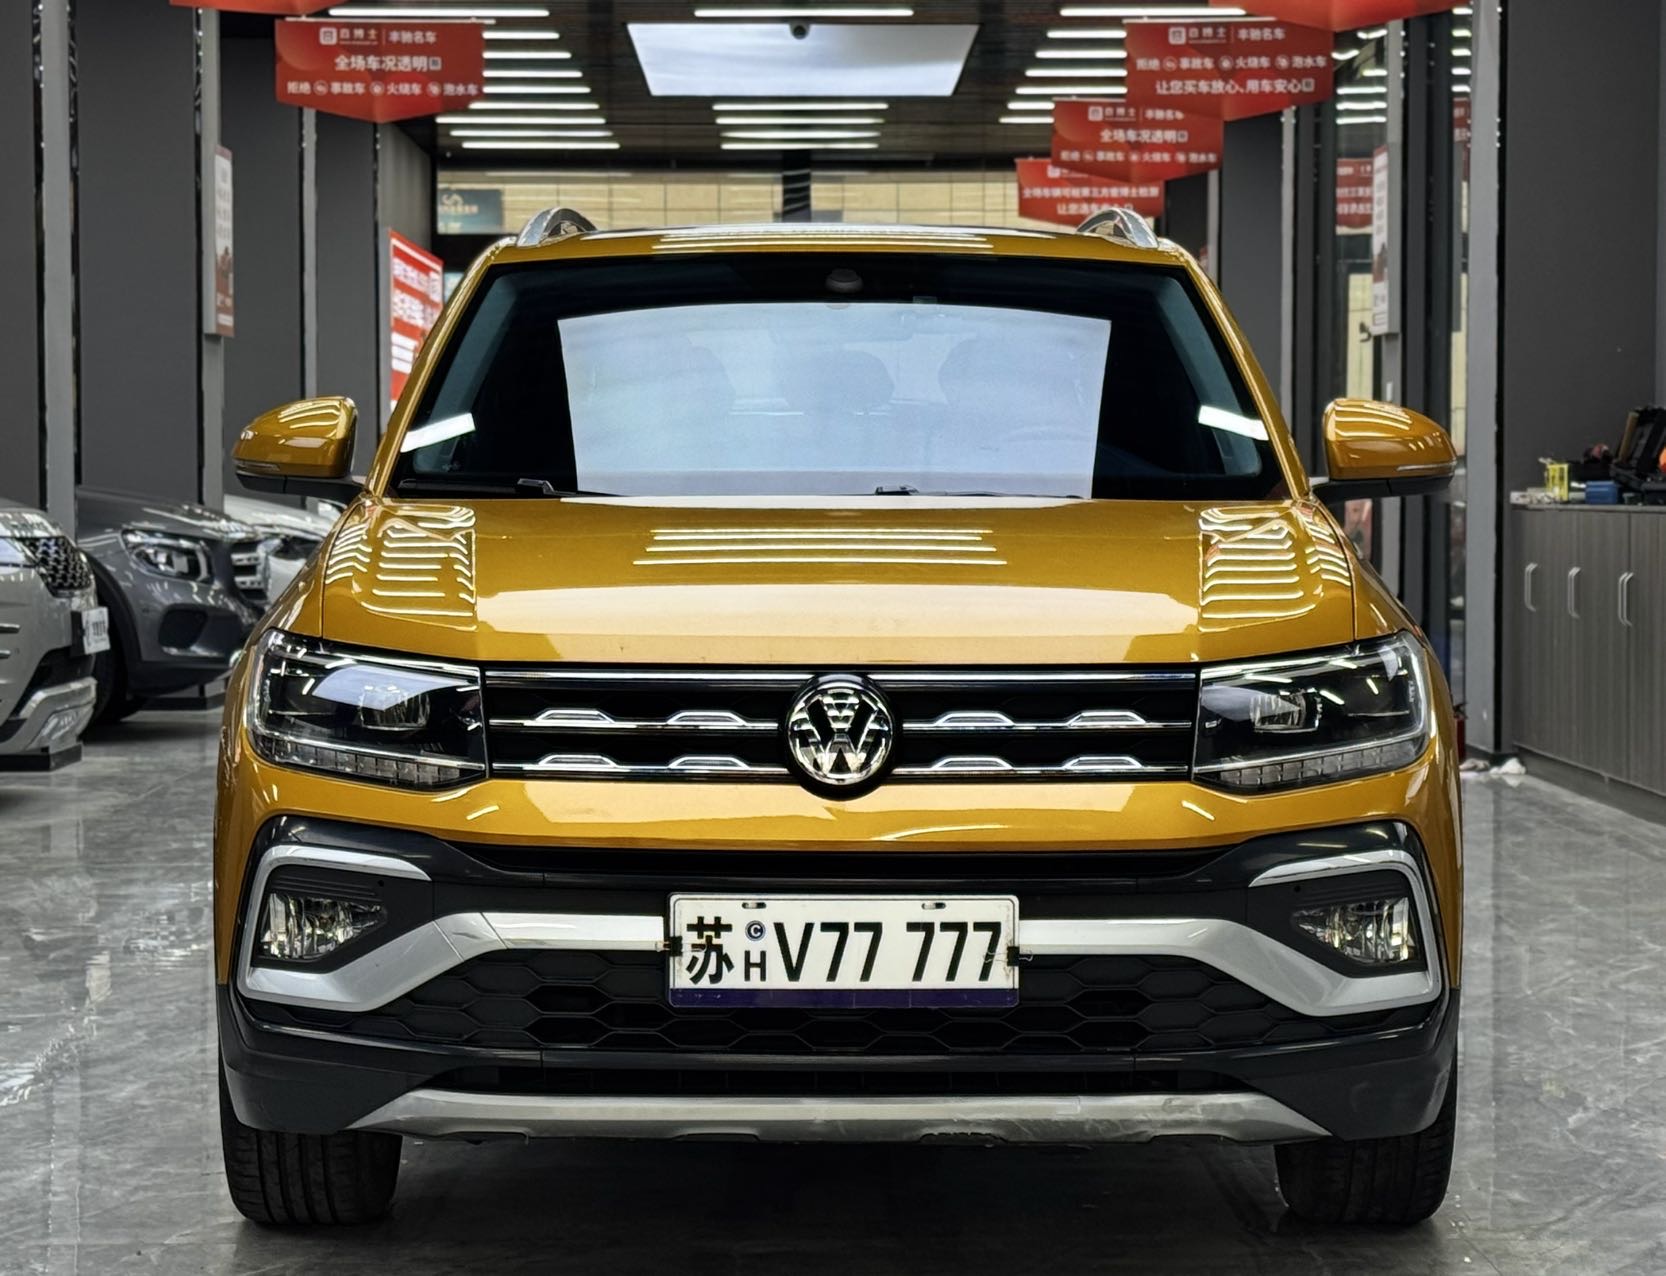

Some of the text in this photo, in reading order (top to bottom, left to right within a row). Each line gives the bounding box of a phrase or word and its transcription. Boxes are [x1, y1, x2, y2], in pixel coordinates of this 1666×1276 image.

[335, 55, 428, 72] 全场车况透明
[1179, 57, 1213, 69] 事故车
[1236, 56, 1270, 68] 火烧车
[1292, 56, 1326, 68] 泡水车
[287, 82, 478, 95] 拒绝 事故车 火烧车 泡水车
[906, 922, 1002, 982] 777
